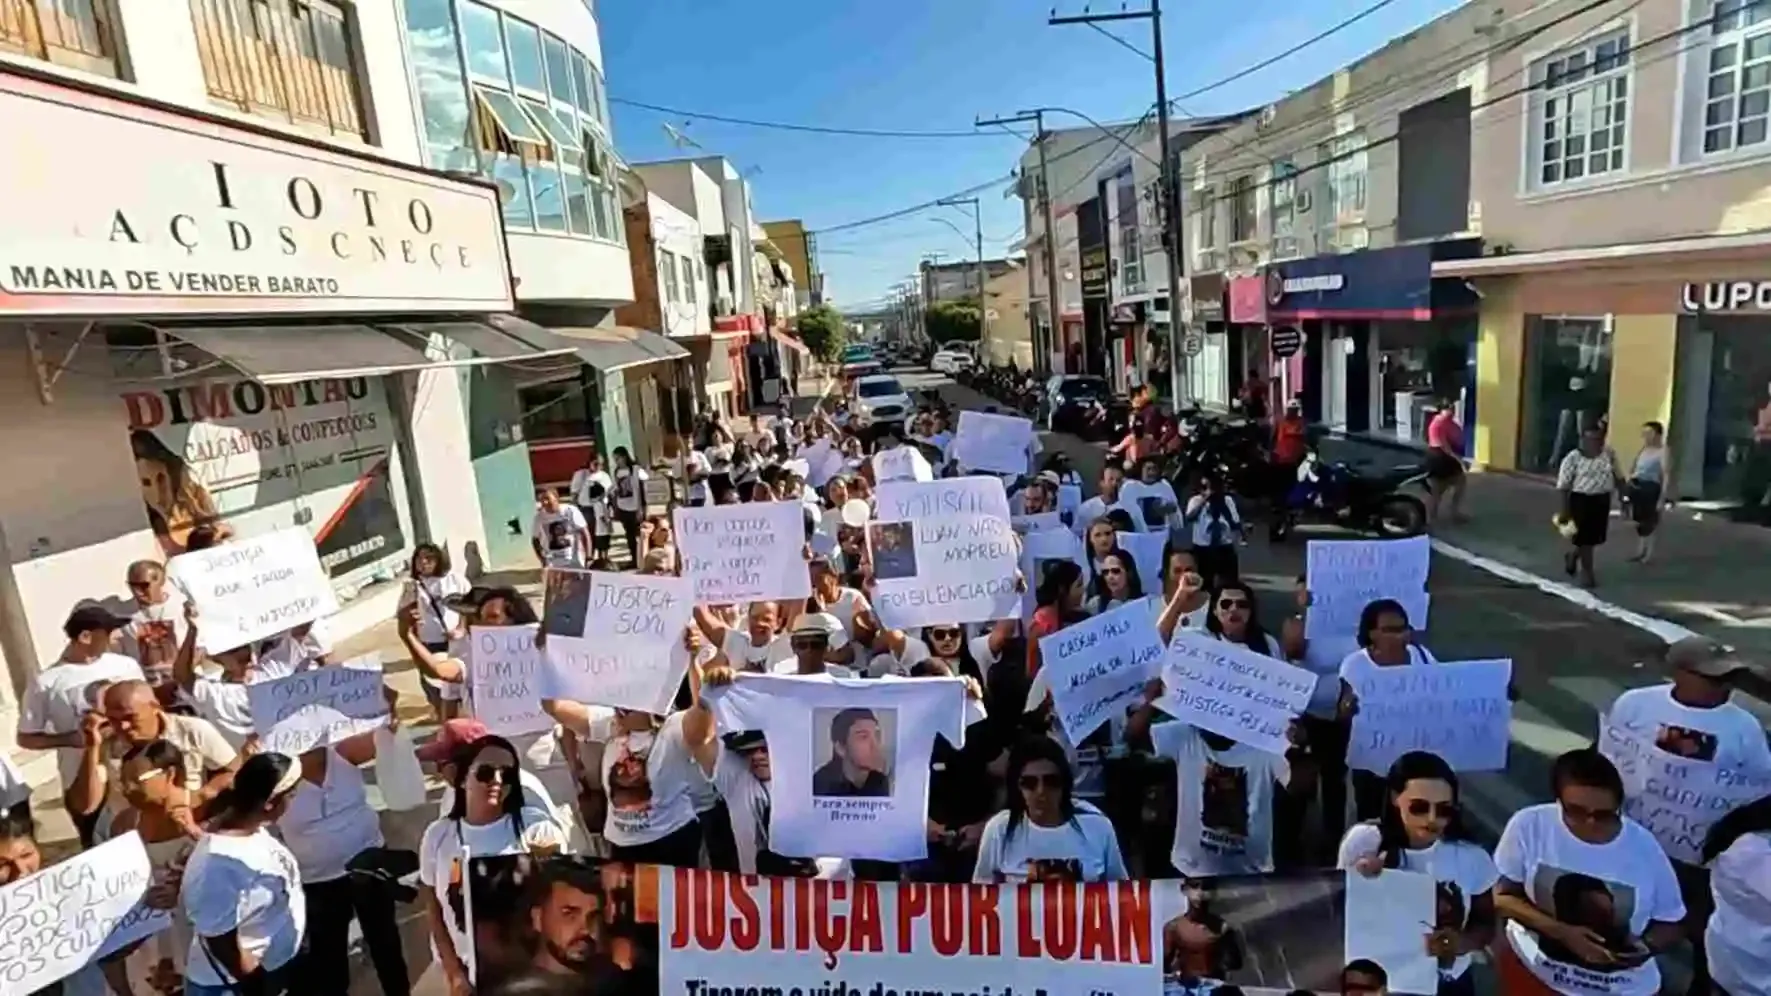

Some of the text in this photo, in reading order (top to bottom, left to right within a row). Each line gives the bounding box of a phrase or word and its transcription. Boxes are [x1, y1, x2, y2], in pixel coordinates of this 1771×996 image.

[10, 265, 339, 294] MANIA DE VENDER BARATO
[671, 868, 1154, 970] JUSTIÇA POR LUAN
